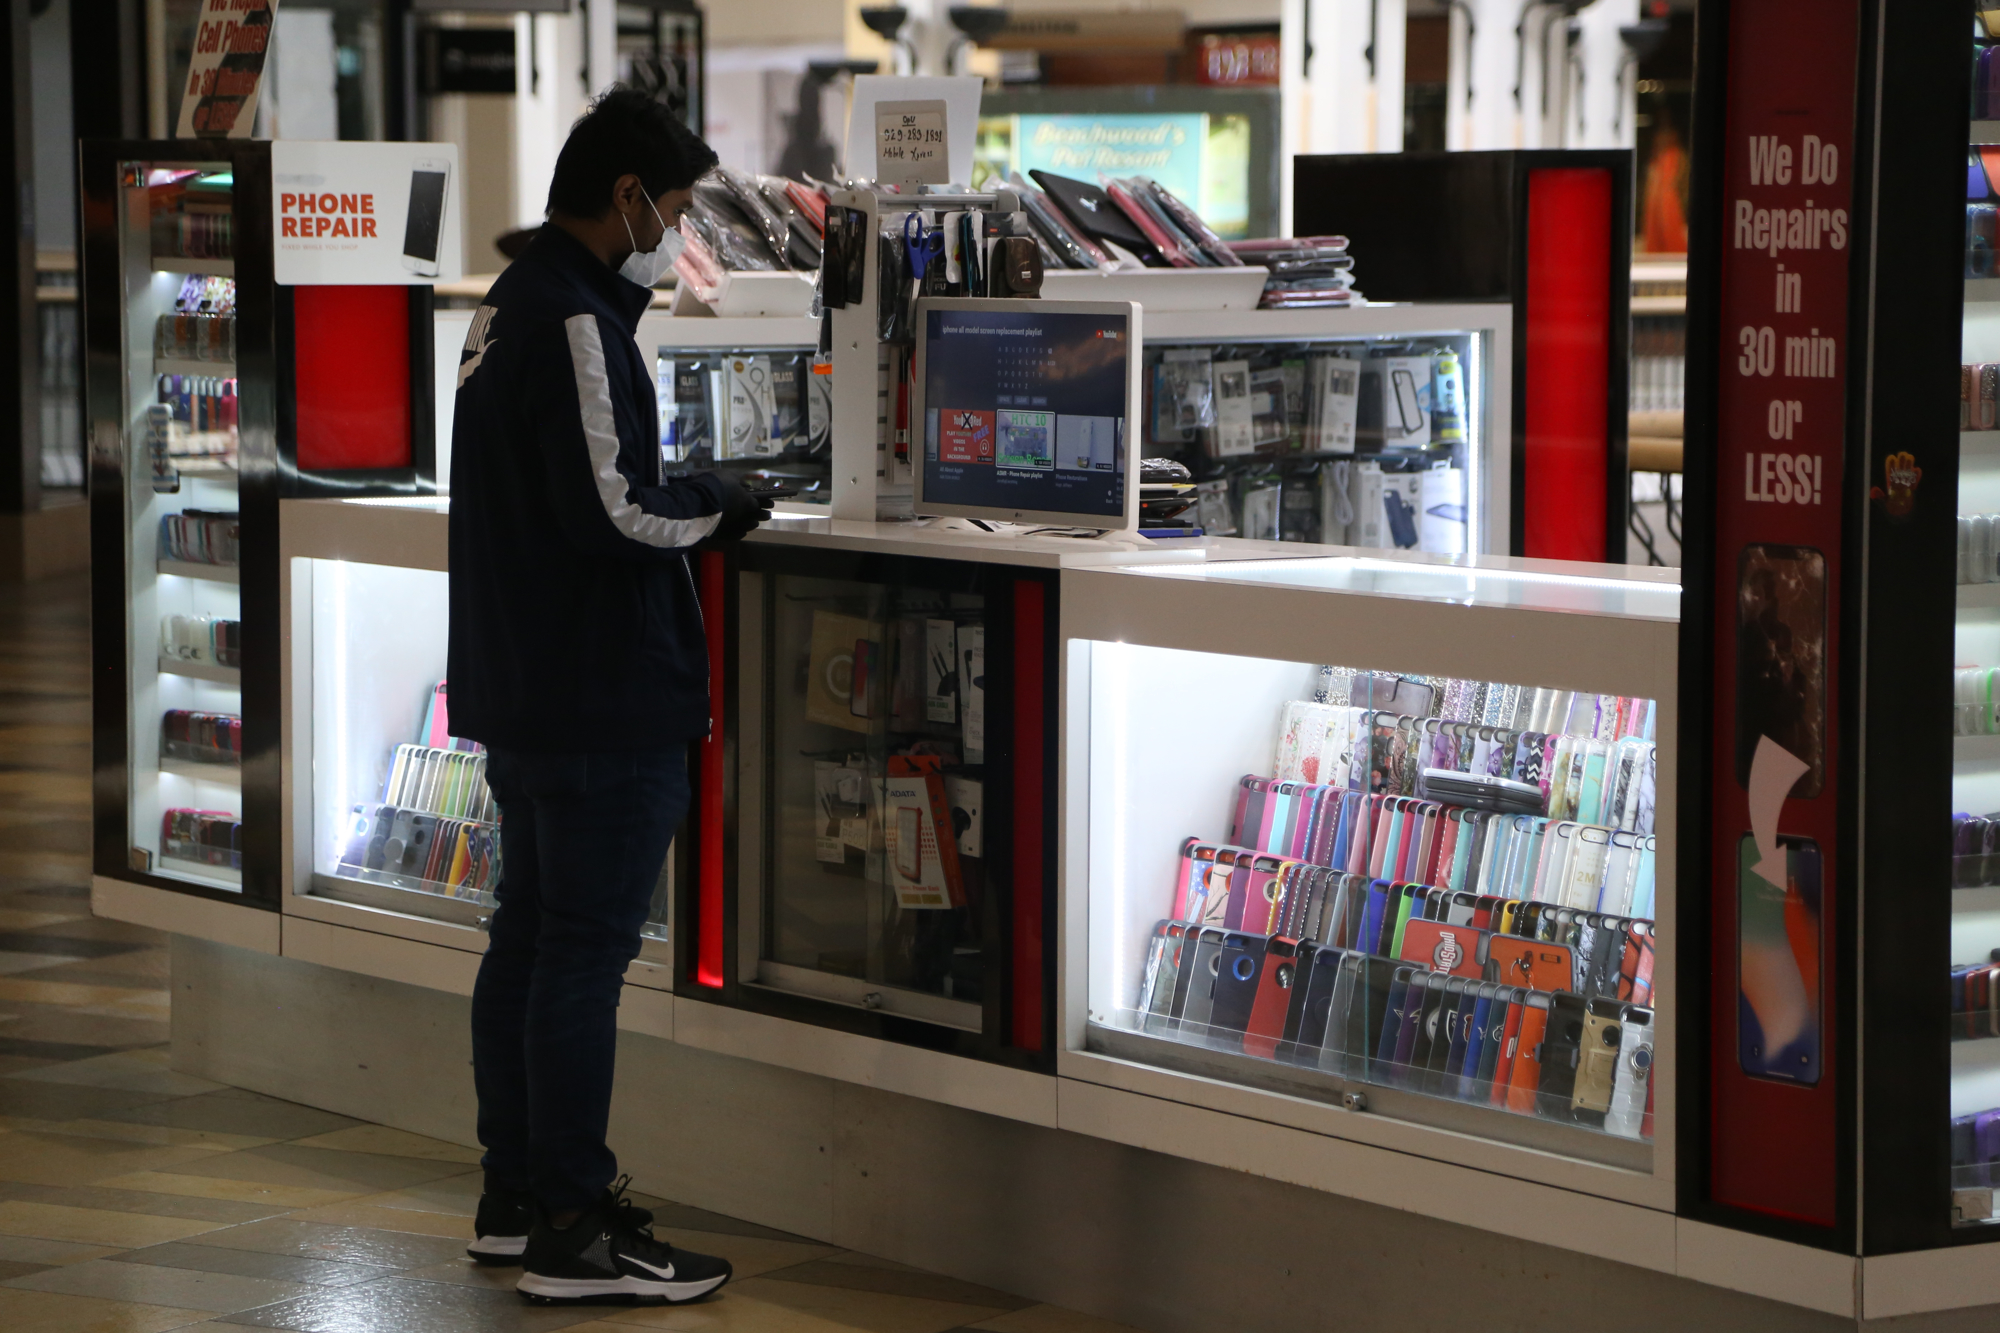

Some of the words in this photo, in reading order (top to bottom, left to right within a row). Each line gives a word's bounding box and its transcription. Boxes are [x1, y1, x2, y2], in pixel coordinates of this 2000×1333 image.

[198, 21, 223, 53] Cell
[221, 20, 268, 54] Phones
[189, 69, 200, 95] In
[1749, 135, 1792, 185] We
[1801, 134, 1838, 185] Do
[281, 193, 374, 214] PHONE
[281, 217, 378, 238] REPAIR
[1734, 199, 1848, 257] Repairs
[1775, 264, 1801, 313] in
[965, 326, 979, 334] model
[996, 327, 1024, 336] replacement
[1025, 328, 1042, 337] playlist
[1738, 326, 1775, 377] 30
[1785, 328, 1836, 378] min
[973, 424, 990, 443] FREE
[1011, 413, 1031, 426] HTC
[1035, 414, 1047, 427] 10
[1768, 399, 1802, 440] or
[1745, 452, 1822, 505] LESS!
